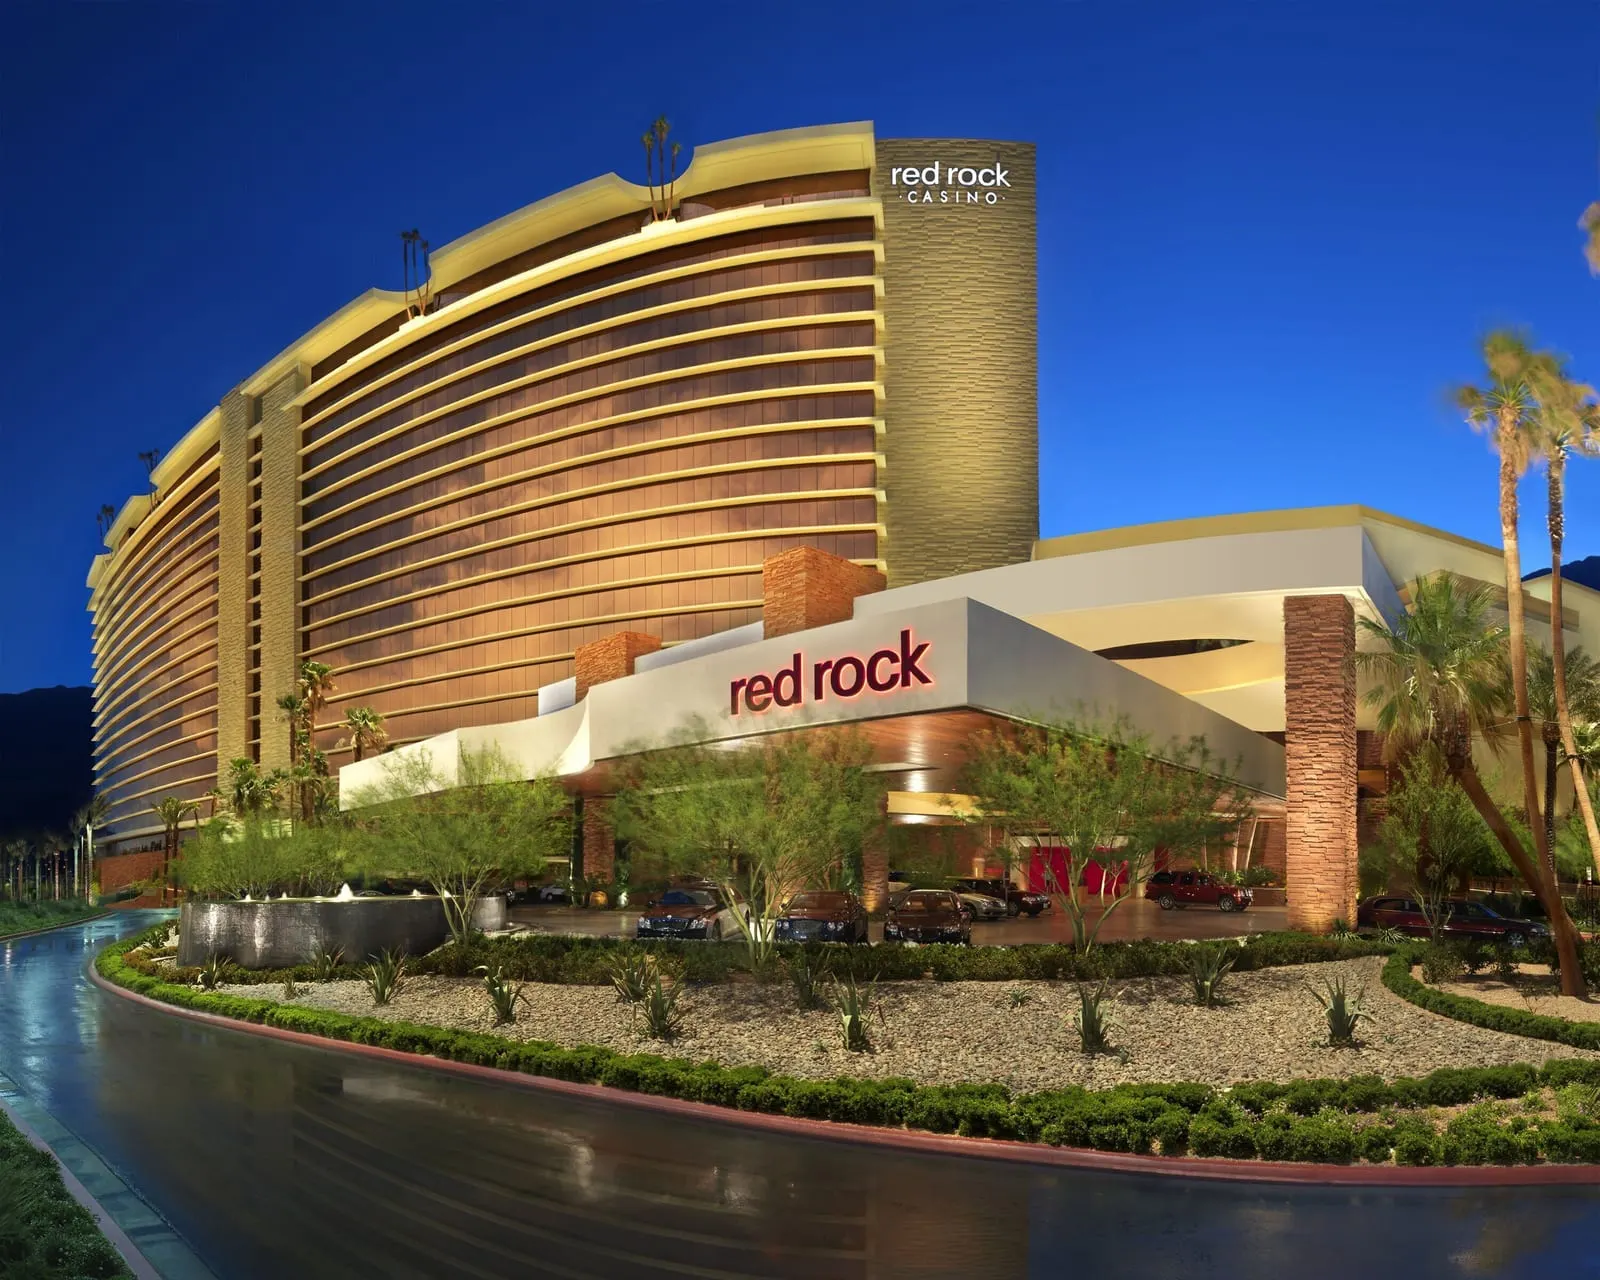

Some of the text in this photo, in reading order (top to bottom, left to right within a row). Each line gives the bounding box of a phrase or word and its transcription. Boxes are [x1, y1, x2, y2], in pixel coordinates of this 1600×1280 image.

[891, 161, 1012, 188] red rock
[907, 190, 998, 204] CASINO
[730, 629, 933, 715] red rock
